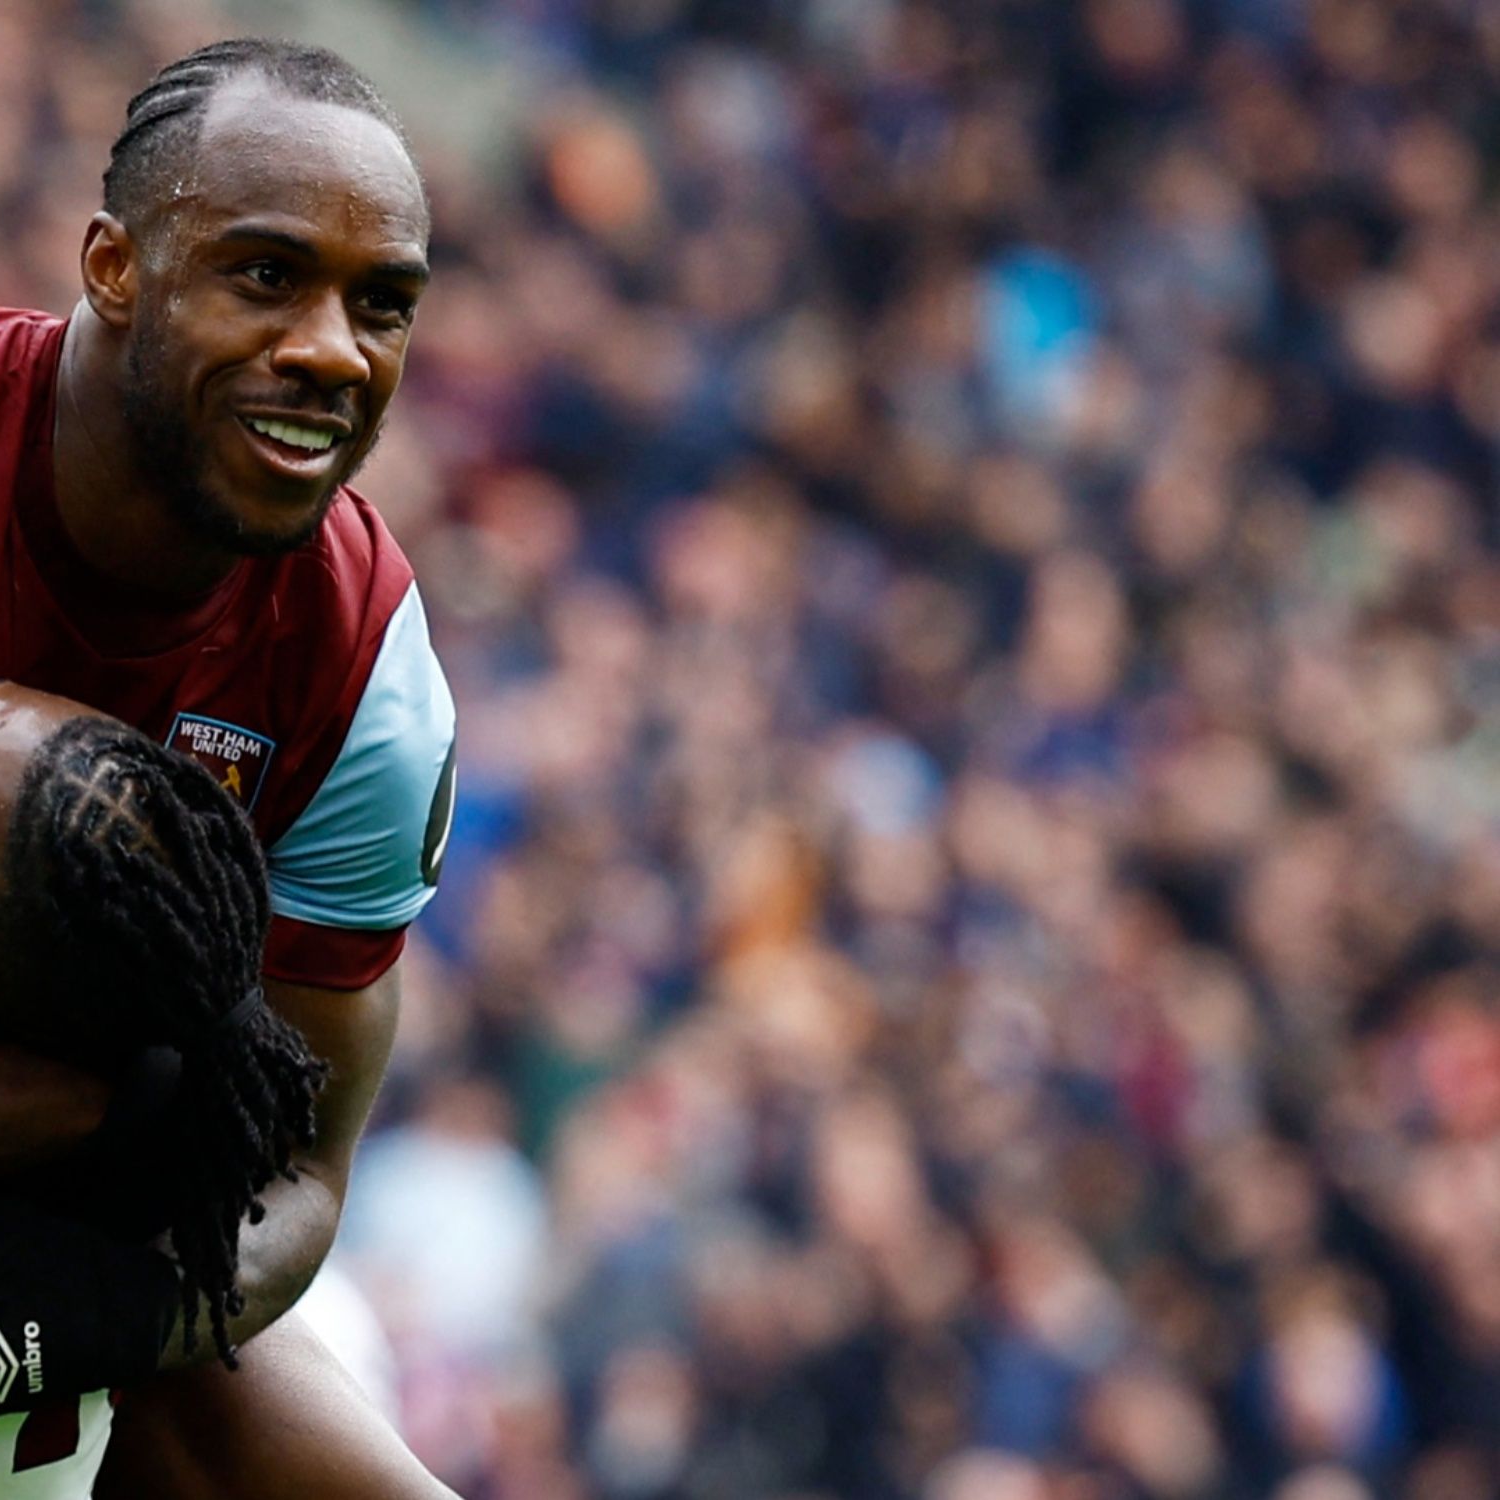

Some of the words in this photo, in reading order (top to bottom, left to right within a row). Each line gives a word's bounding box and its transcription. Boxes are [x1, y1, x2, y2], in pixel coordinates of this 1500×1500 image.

[180, 721, 223, 741] WEST
[223, 730, 261, 757] HAM
[192, 737, 241, 762] UNITED
[22, 1320, 43, 1393] umbro
